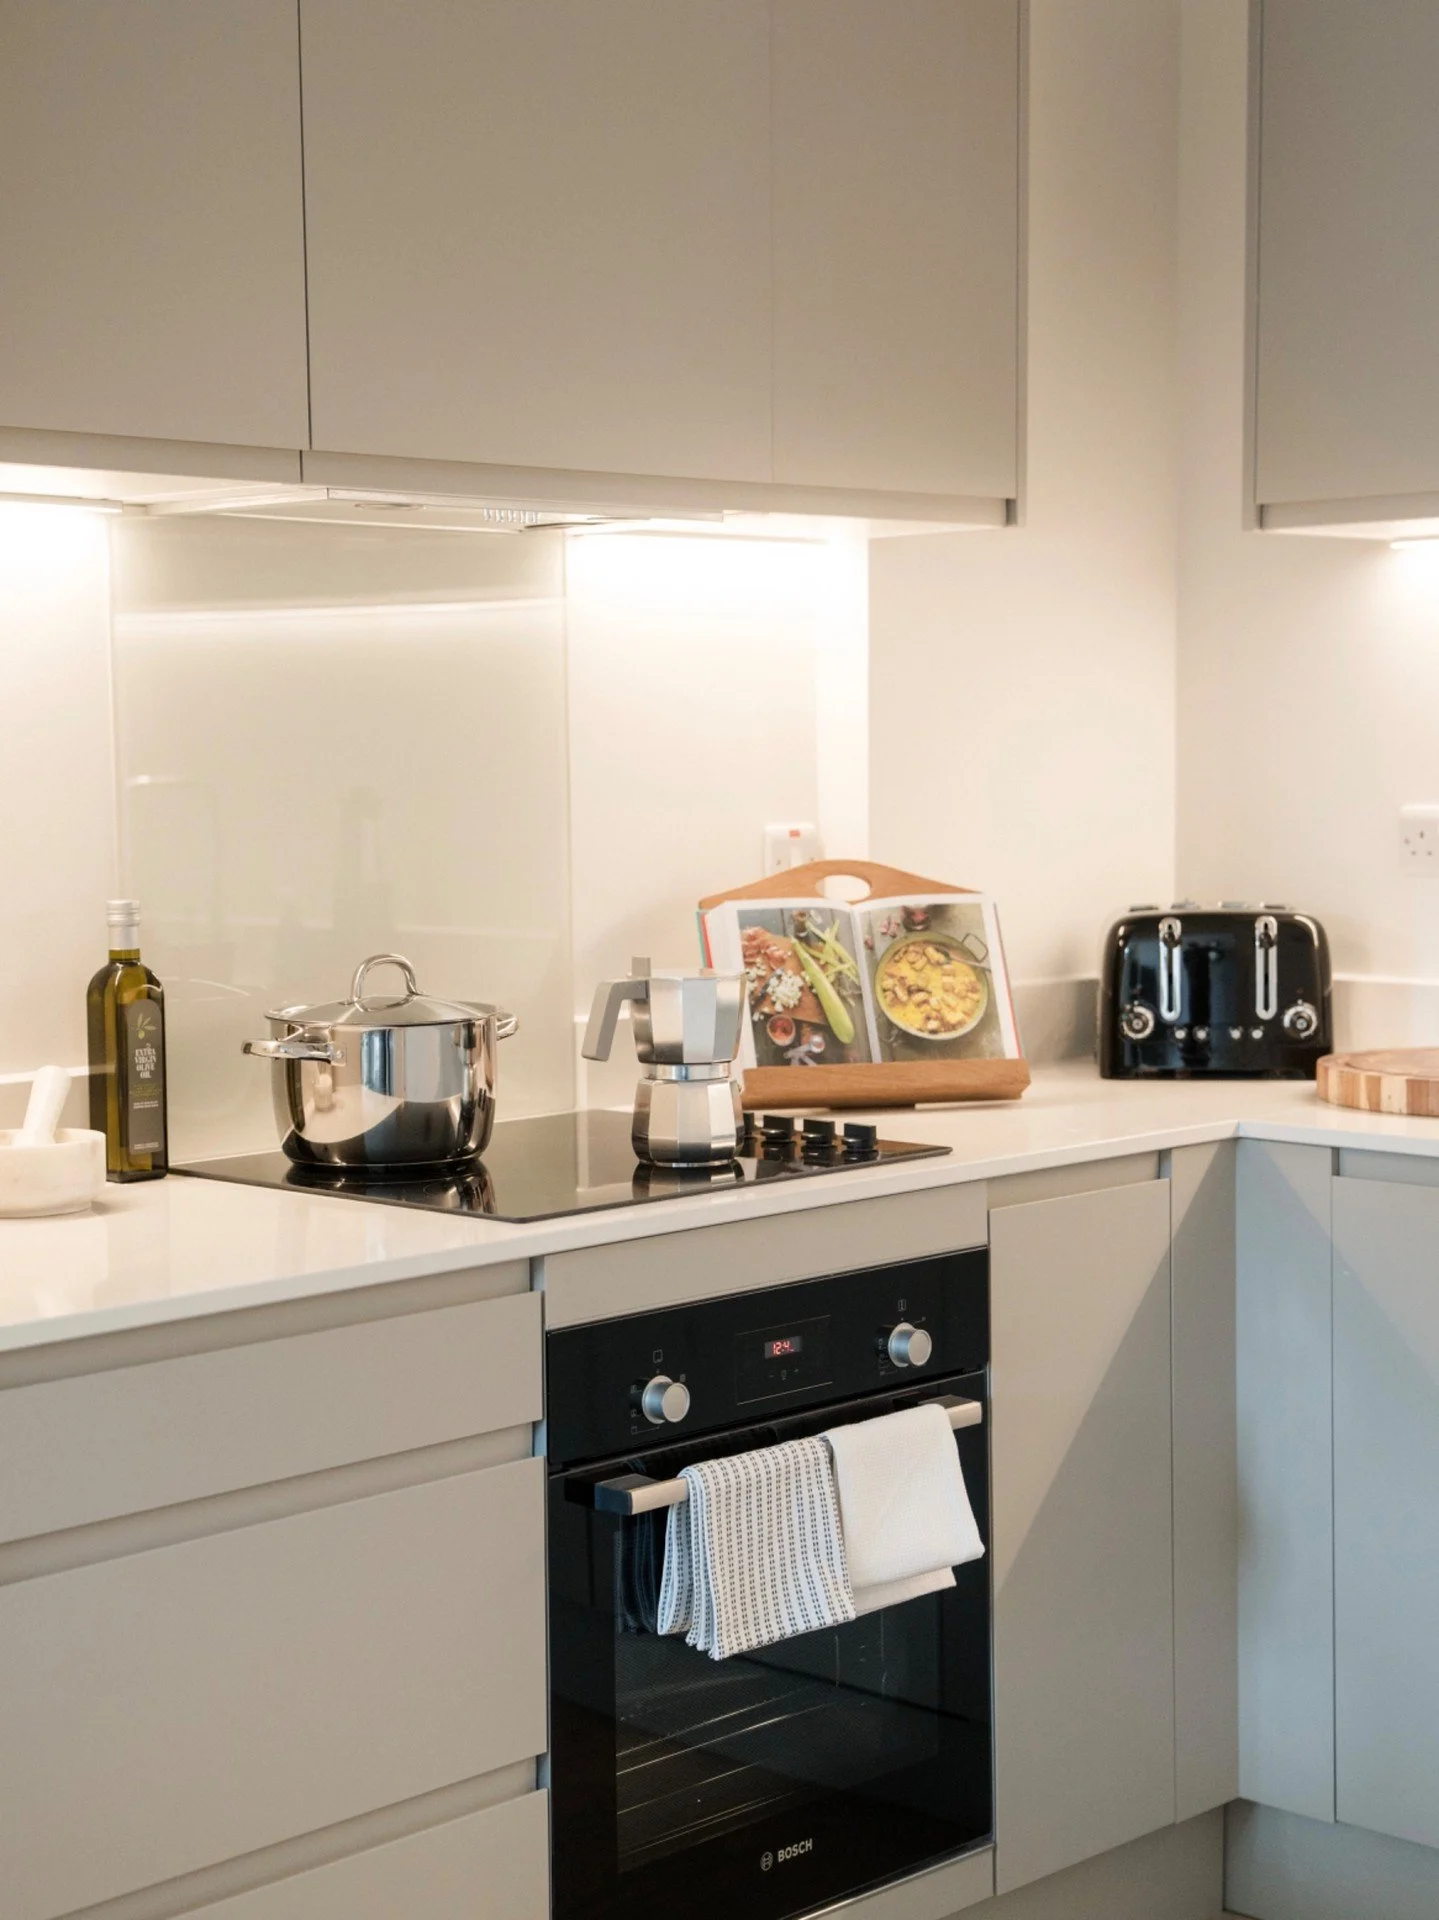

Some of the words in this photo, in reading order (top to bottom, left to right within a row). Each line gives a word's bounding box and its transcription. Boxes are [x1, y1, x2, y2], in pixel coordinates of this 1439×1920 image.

[135, 1048, 156, 1056] EXTRA
[135, 1055, 157, 1063] VIRGIN
[136, 1063, 155, 1071] OLIVE
[140, 1071, 152, 1079] OIL
[778, 1838, 813, 1863] BOSCH
